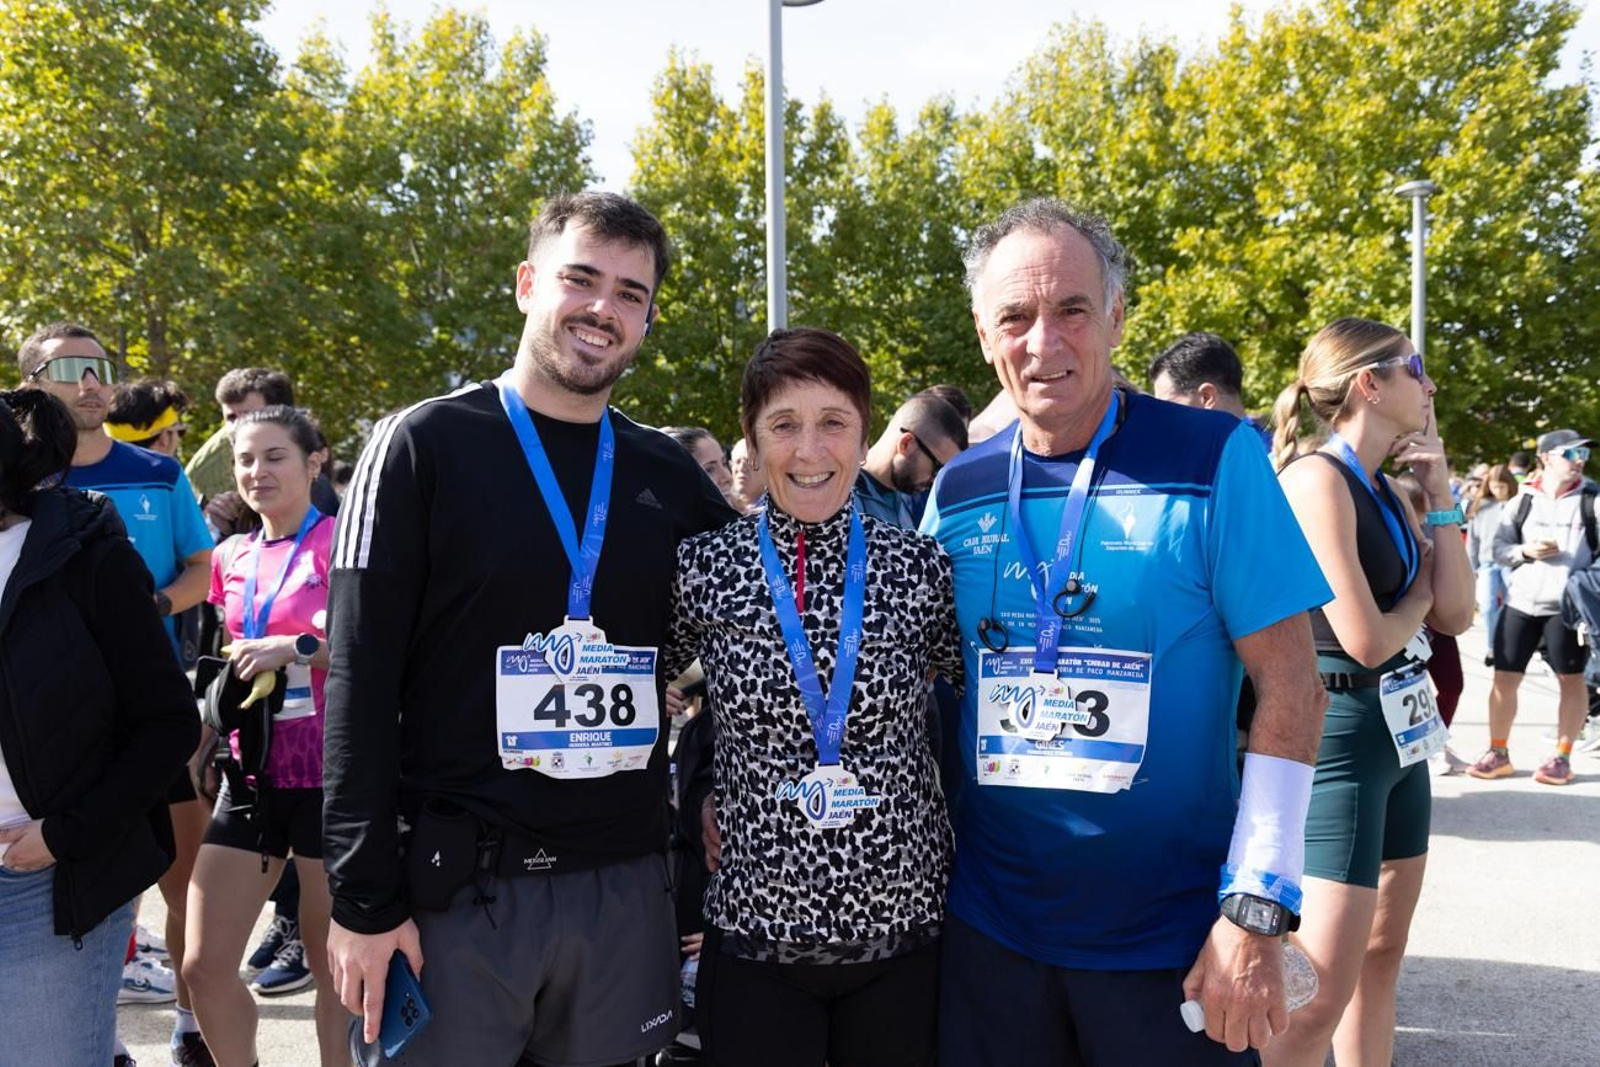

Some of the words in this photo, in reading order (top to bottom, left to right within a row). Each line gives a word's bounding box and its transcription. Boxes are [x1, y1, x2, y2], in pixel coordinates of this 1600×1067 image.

[581, 644, 613, 652] MEDIA
[579, 655, 628, 664] MARATÓN
[575, 666, 600, 675] JAÉN
[533, 683, 636, 728] 438
[1043, 699, 1074, 709] MEDIA
[1402, 686, 1435, 726] 29
[1039, 710, 1088, 722] MARATÓN
[1034, 721, 1059, 731] JAÉN
[570, 732, 611, 742] ENRIQUE
[833, 788, 865, 796] MEDIA
[831, 798, 879, 808] MARATÓN
[828, 809, 852, 819] JAÉN
[641, 1010, 673, 1033] LIXADA
